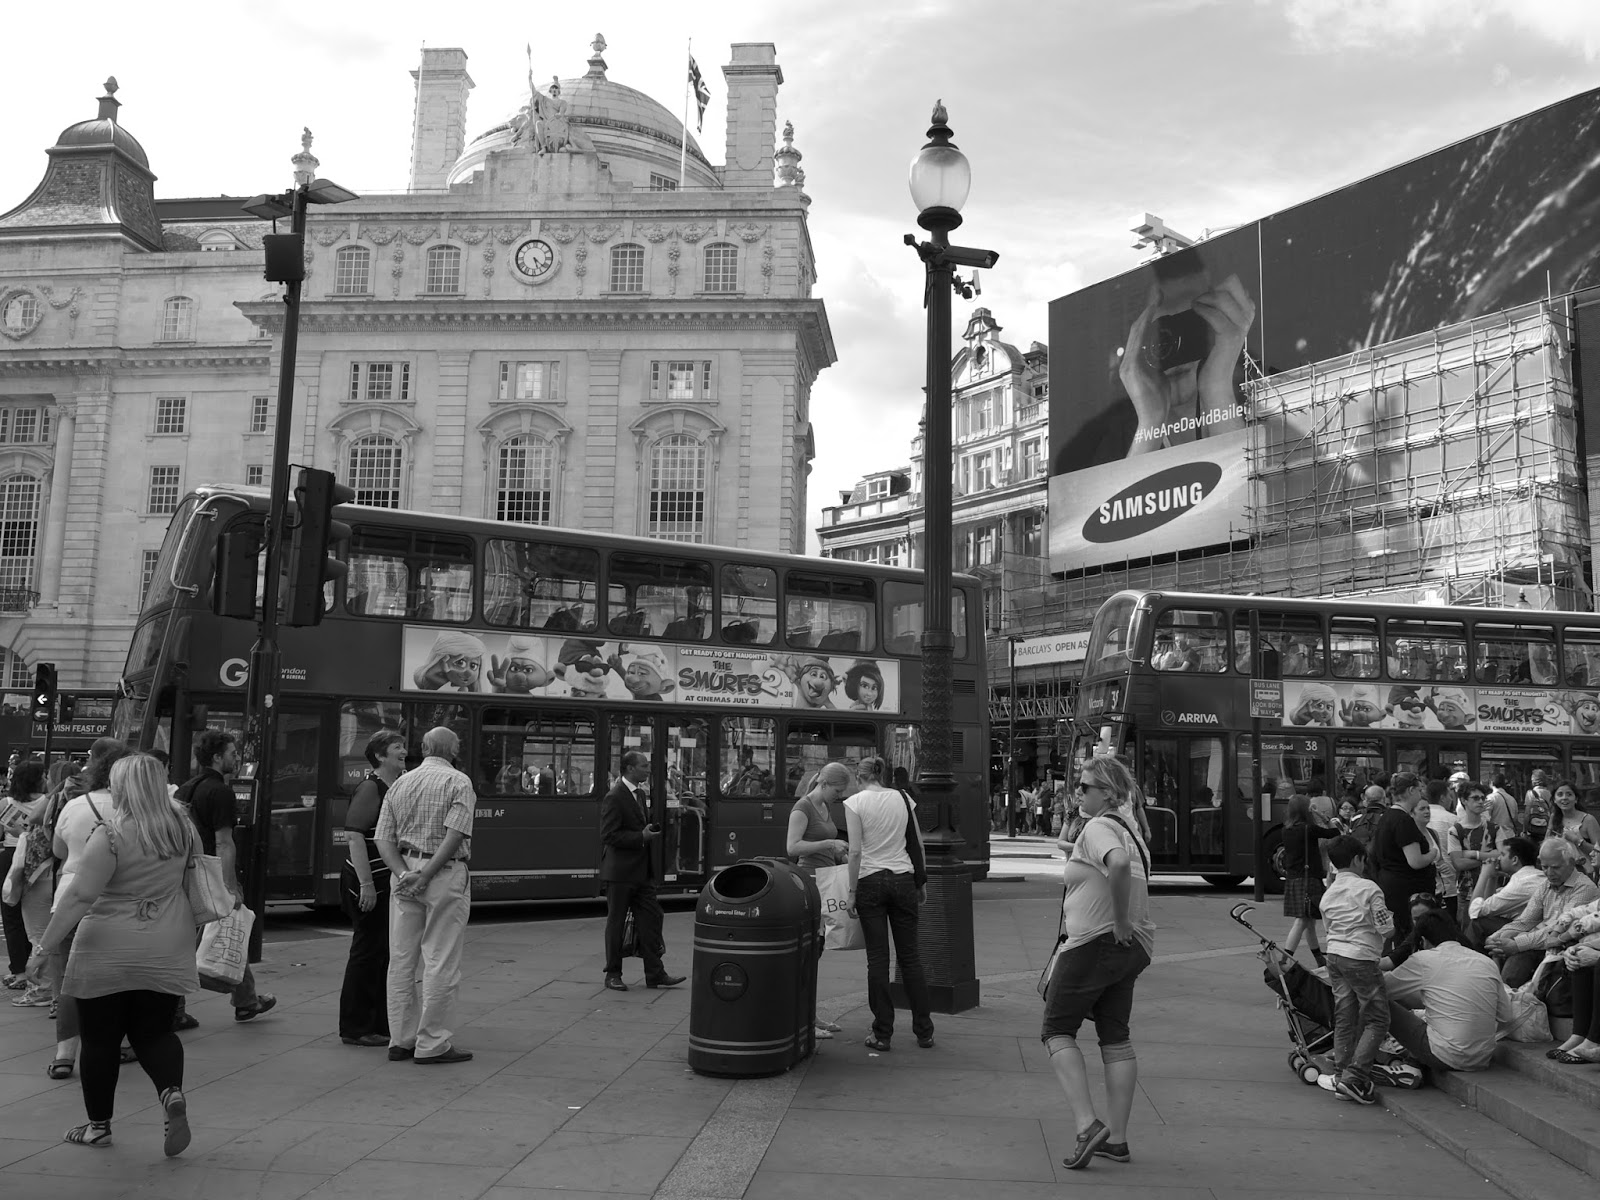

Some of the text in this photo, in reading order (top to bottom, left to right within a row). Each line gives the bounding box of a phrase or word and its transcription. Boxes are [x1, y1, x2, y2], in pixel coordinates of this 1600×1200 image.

[1099, 482, 1203, 525] SAMSUNG
[1018, 643, 1052, 656] BARCLAYS
[1055, 641, 1076, 652] OPEN
[735, 652, 768, 661] NAUGHTY!
[281, 667, 306, 675] ondon
[713, 660, 733, 671] THE
[678, 667, 763, 696] SMURFS
[1503, 698, 1519, 707] THE
[1178, 712, 1219, 724] ARRIVA
[1478, 704, 1545, 726] SMURFS
[44, 724, 71, 732] LVISH
[72, 724, 95, 732] FEAST
[1261, 742, 1278, 750] Essex
[1304, 740, 1318, 751] 38
[348, 769, 361, 777] via
[494, 809, 505, 817] AF
